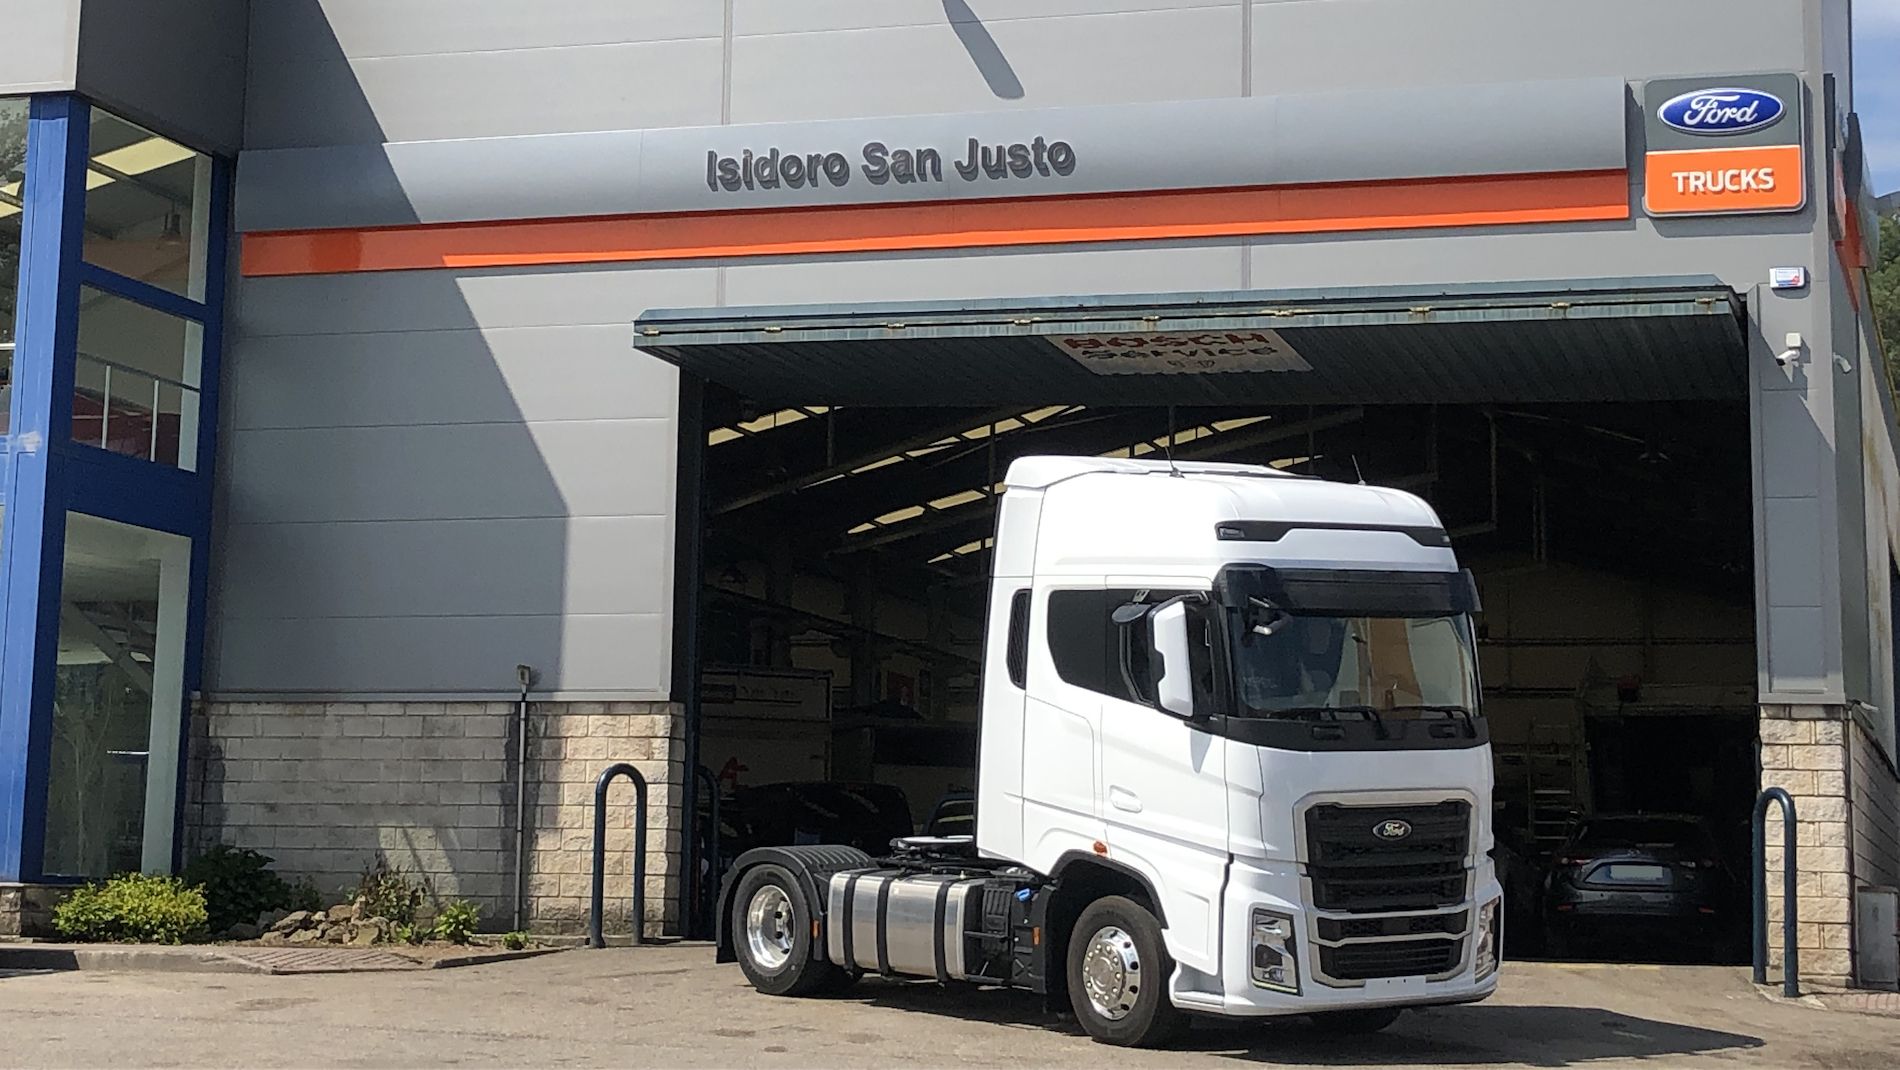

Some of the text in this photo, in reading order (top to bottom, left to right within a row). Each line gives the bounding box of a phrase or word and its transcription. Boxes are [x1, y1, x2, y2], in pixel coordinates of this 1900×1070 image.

[1683, 95, 1759, 126] Ford
[706, 136, 1077, 192] Isidoro San Justo
[1672, 167, 1775, 194] TRUCKS
[1063, 332, 1271, 349] BOSCH
[1081, 345, 1278, 360] Service
